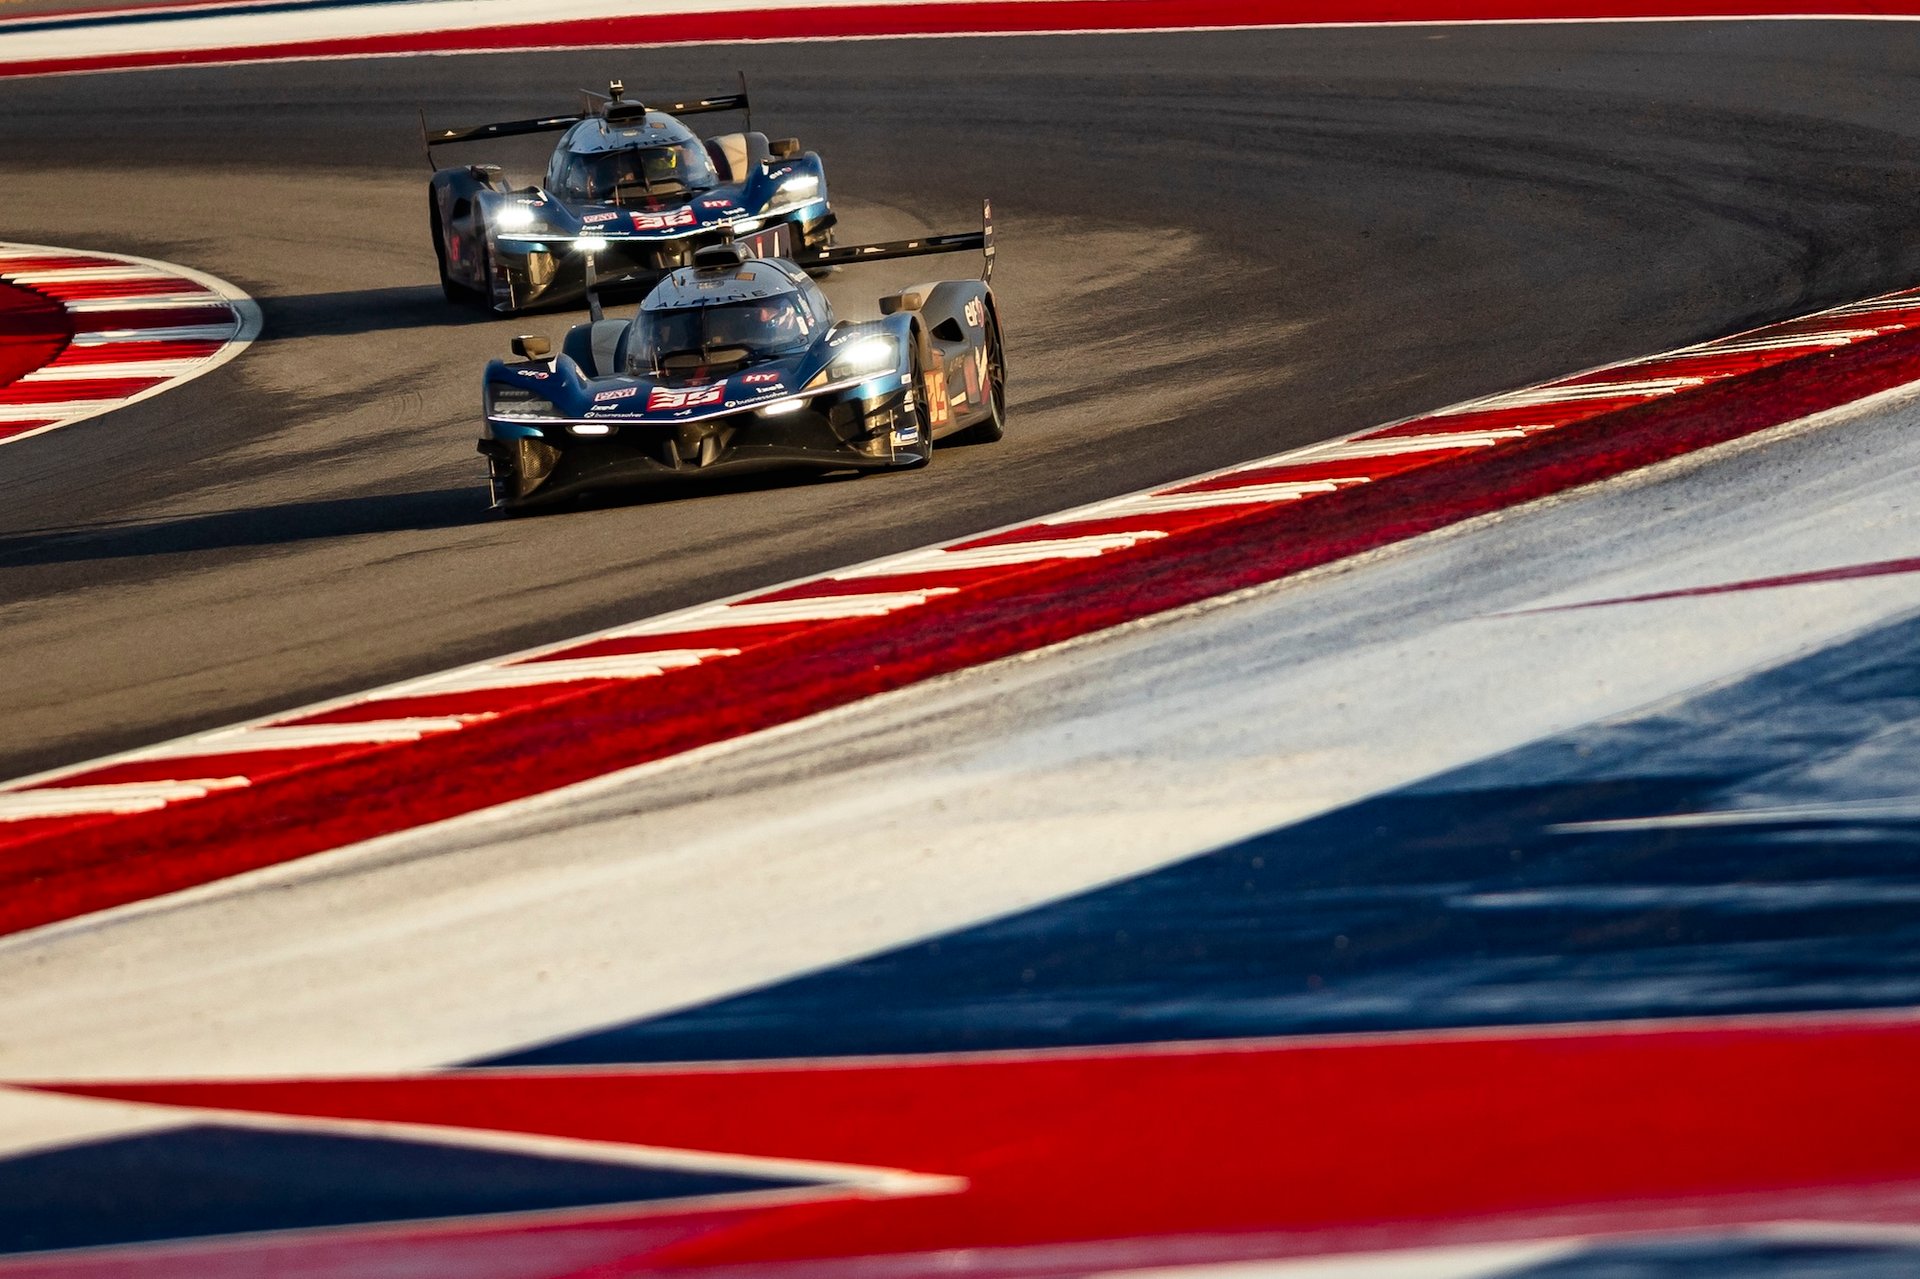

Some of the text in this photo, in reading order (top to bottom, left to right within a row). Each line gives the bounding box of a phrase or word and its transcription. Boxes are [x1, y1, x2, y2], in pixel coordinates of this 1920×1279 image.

[636, 211, 693, 229] 36
[655, 290, 768, 309] ALPINE
[745, 374, 777, 382] HY
[650, 386, 723, 409] 35
[924, 371, 948, 423] 35
